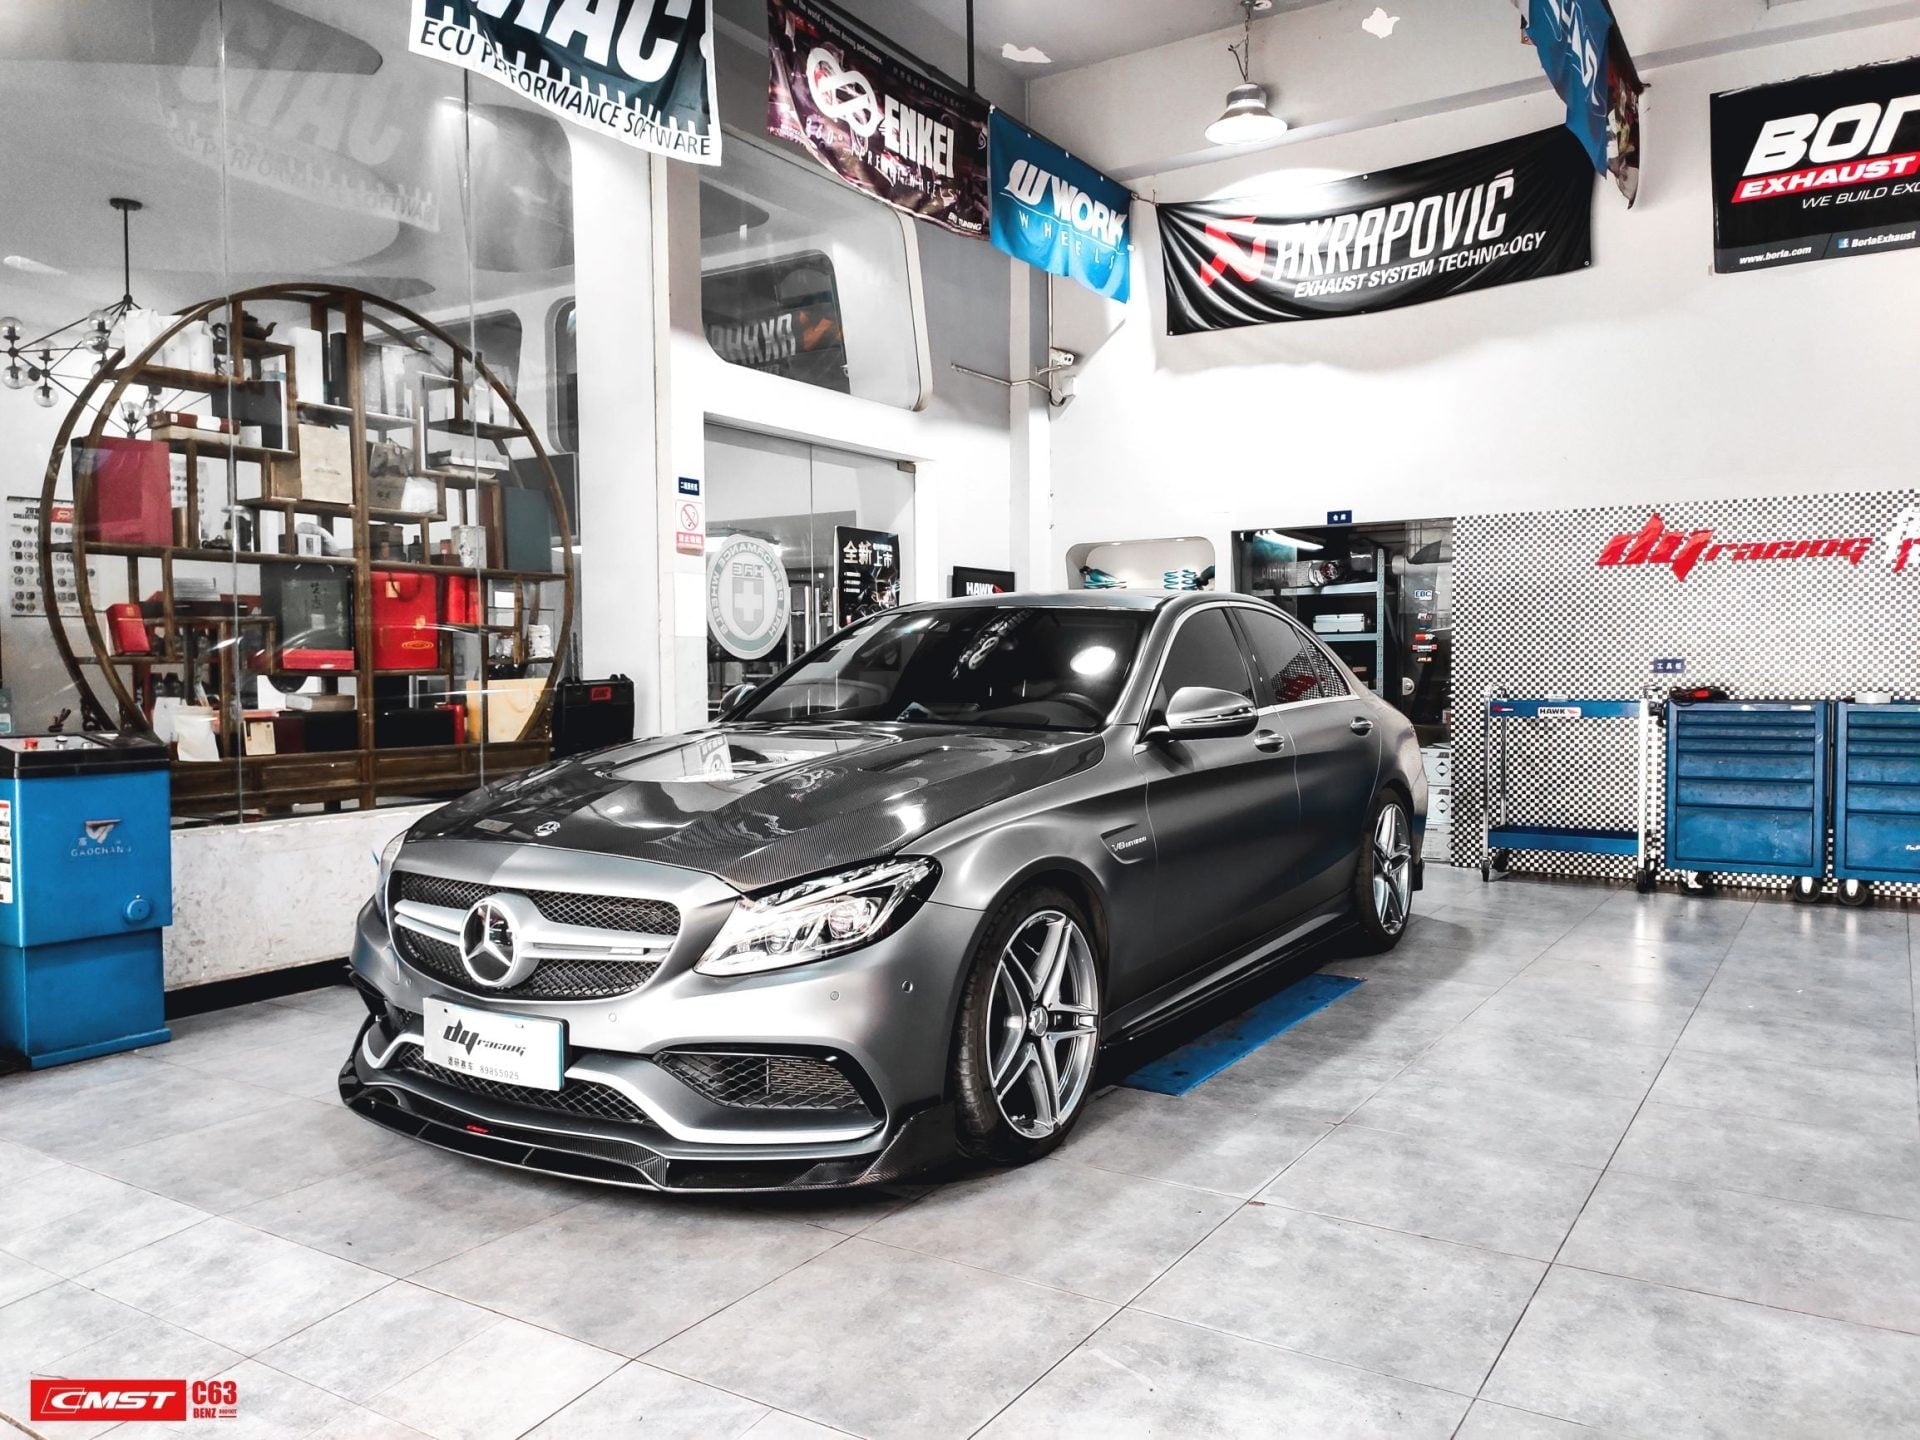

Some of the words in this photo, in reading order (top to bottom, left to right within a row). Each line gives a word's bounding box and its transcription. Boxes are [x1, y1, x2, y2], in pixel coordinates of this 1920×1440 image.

[420, 21, 475, 56] ECU
[624, 113, 711, 156] SOFTWARE
[884, 95, 955, 178] ENKEI
[1740, 156, 1916, 199] EXHAUST
[1801, 195, 1833, 209] WE
[1835, 187, 1888, 205] BUILD
[1019, 210, 1115, 269] WHEELS
[1051, 175, 1127, 250] WORK
[1294, 275, 1368, 299] EXHAUST
[1368, 260, 1434, 287] SYSTEM
[1437, 231, 1547, 274] TECHNOLOGY
[1739, 246, 1812, 264] www.borla.com
[1851, 230, 1916, 248] BorlaExhaust
[843, 540, 872, 566] 全新
[873, 552, 893, 569] 上市
